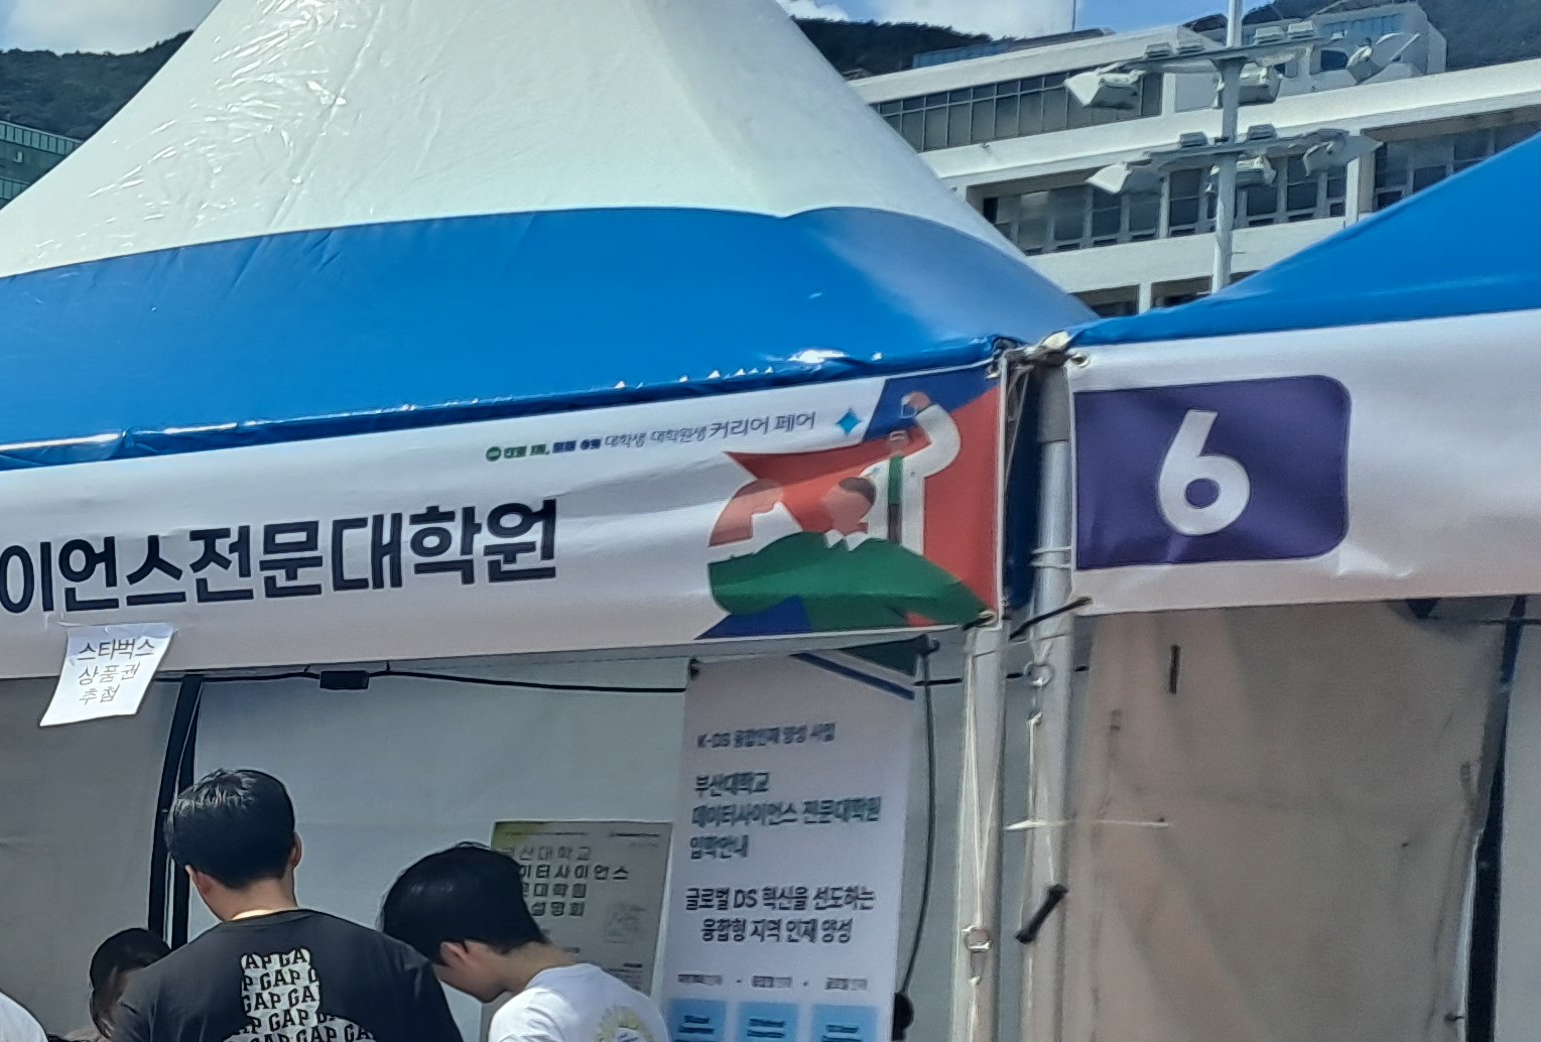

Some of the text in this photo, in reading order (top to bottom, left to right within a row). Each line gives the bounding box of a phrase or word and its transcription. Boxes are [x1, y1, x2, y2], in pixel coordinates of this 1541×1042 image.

[1158, 409, 1251, 536] 6
[77, 638, 155, 661] 스타벅스
[78, 660, 141, 686] 상품권
[518, 864, 629, 881] 이터사이언스
[733, 888, 758, 909] DS
[259, 968, 301, 991] GAP
[268, 1009, 310, 1032] GAP
